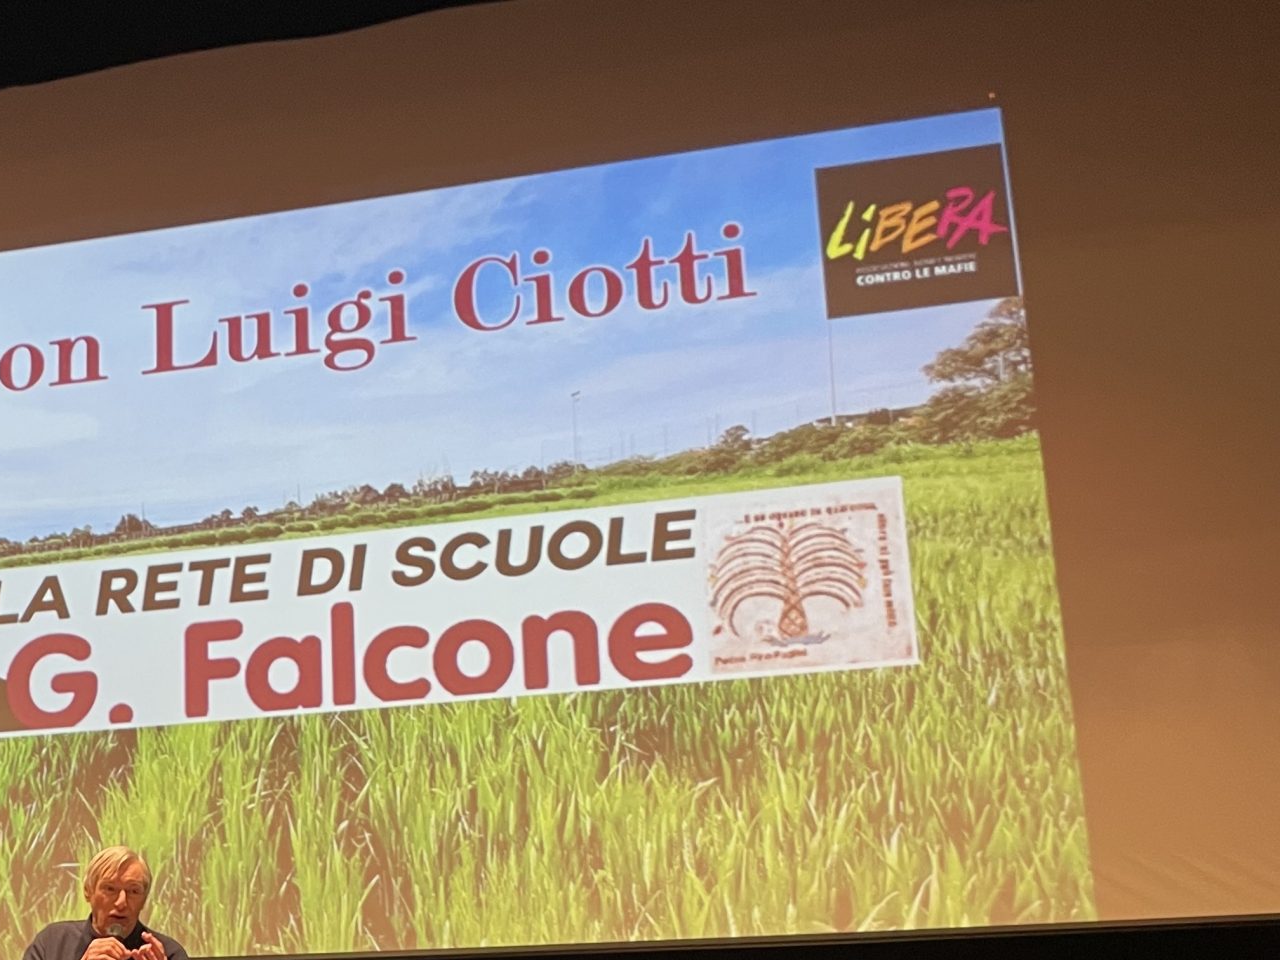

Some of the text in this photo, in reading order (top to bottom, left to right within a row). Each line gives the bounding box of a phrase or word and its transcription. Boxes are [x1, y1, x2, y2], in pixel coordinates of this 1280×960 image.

[141, 270, 417, 375] Luigi
[454, 223, 757, 331] Ciotti
[856, 270, 912, 286] CONTRO
[915, 267, 930, 279] LE
[934, 261, 976, 275] MAFIE
[95, 553, 272, 616] RETE
[297, 544, 367, 597] DI
[391, 509, 696, 587] SCUOLE
[6, 602, 694, 729] G. Falcone
